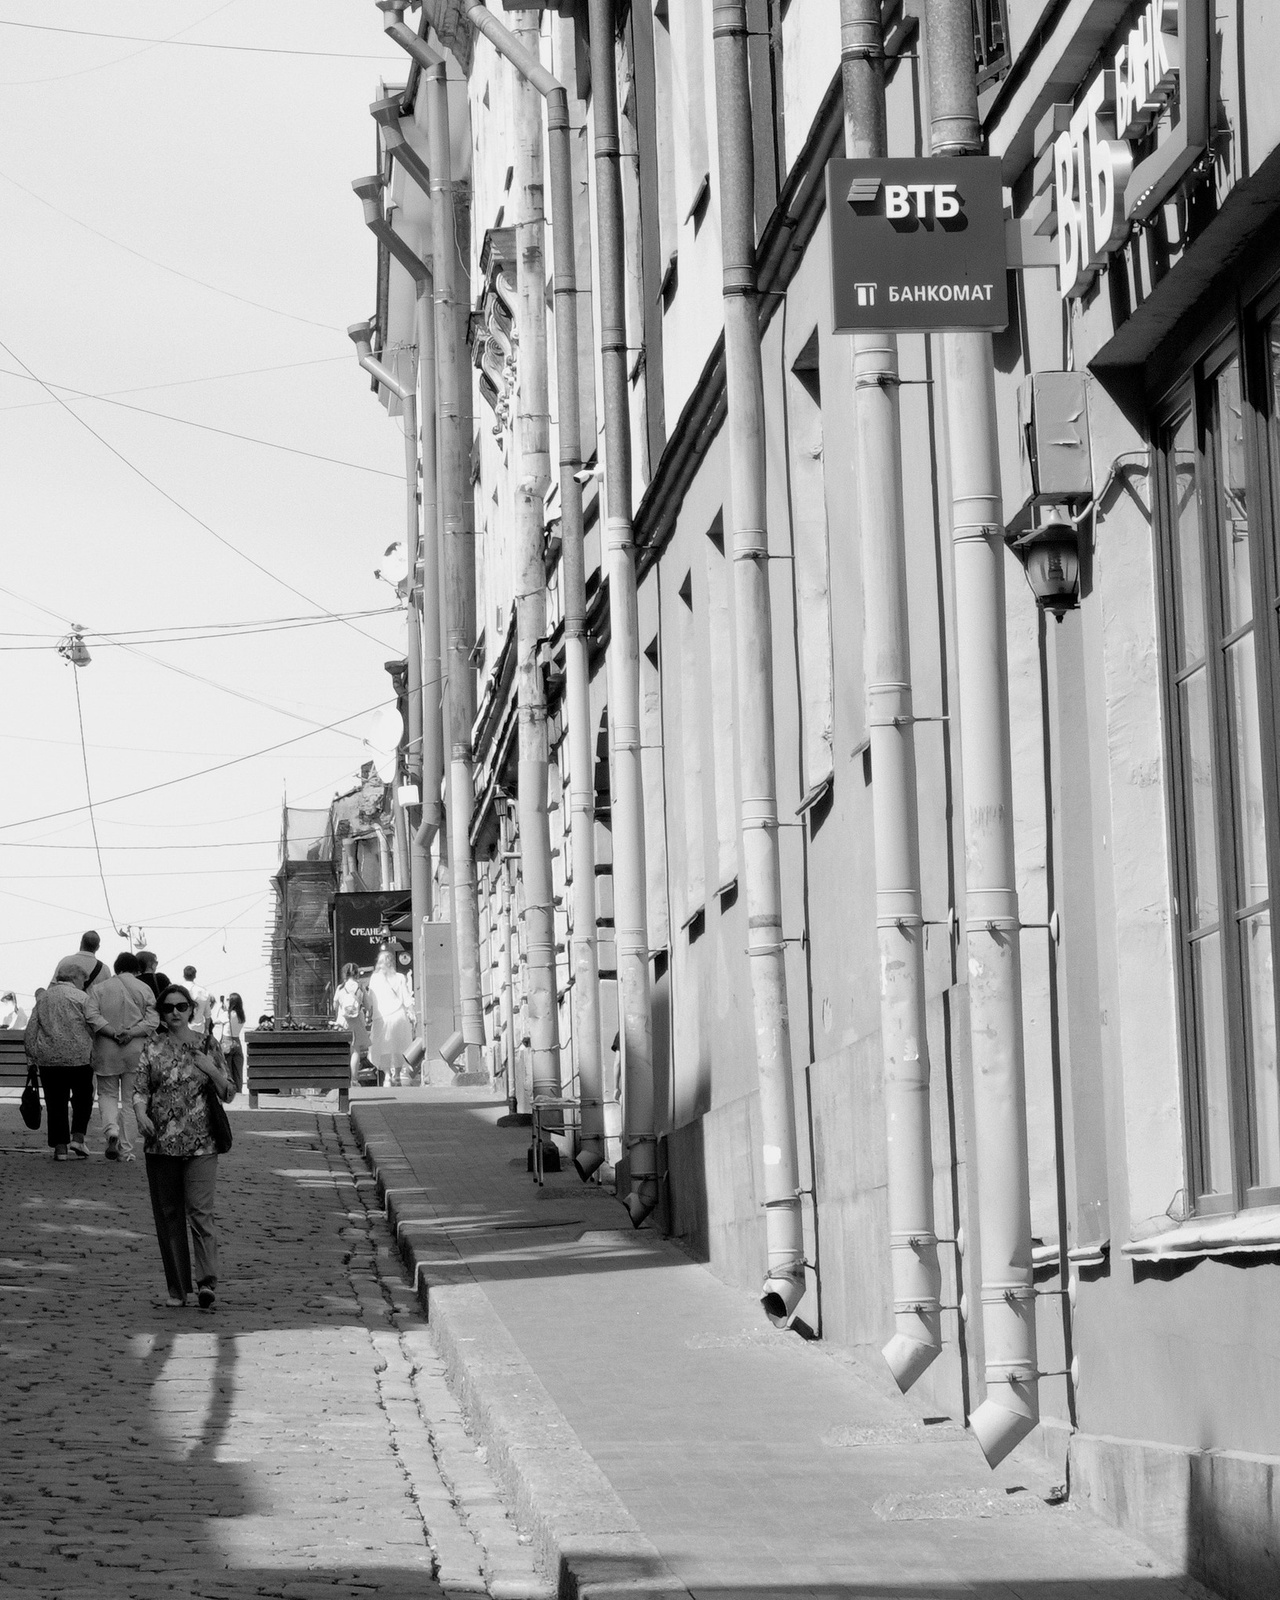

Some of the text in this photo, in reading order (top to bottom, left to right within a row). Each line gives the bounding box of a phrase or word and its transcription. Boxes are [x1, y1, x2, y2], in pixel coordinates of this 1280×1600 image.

[1054, 69, 1118, 298] ВТБ
[885, 184, 960, 219] ВТБ
[889, 284, 994, 302] БАНКОМАТ
